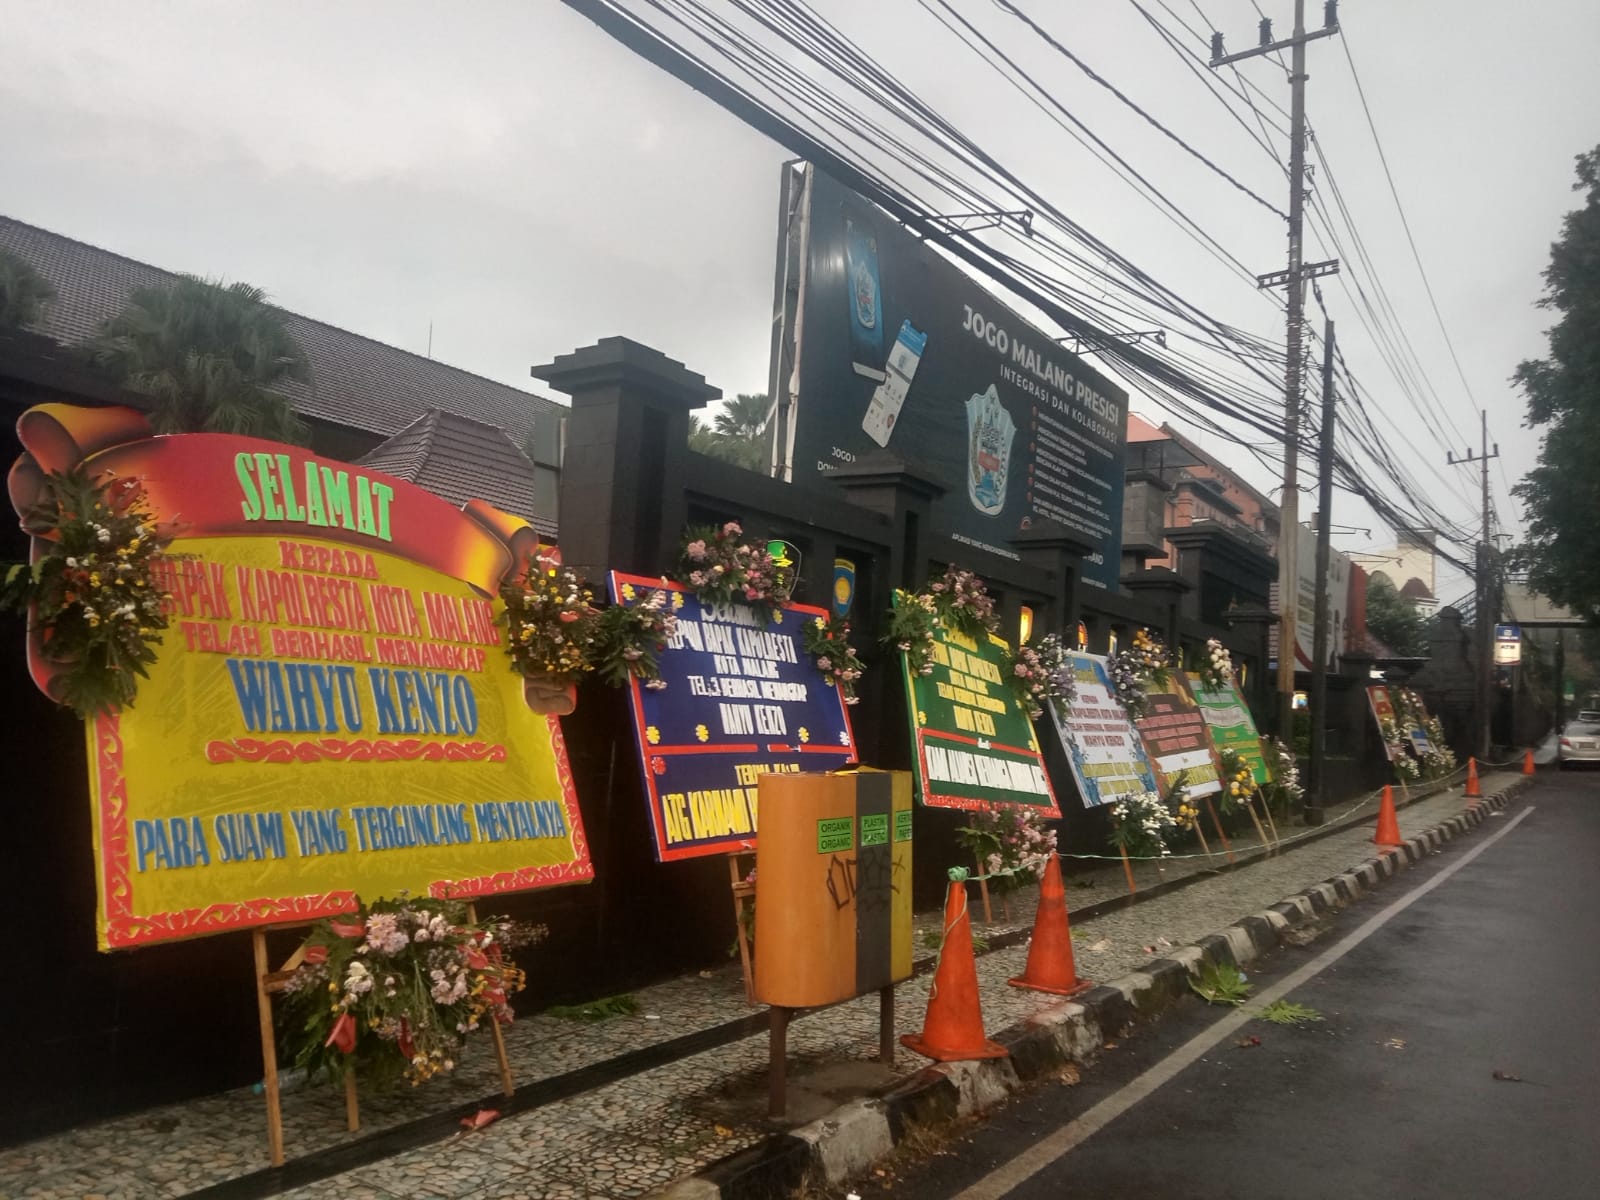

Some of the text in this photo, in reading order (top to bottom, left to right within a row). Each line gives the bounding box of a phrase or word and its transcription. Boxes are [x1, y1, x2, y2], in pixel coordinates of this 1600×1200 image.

[962, 304, 1119, 426] JOGO MALANG PRESISI
[1000, 363, 1049, 404] INTEGRASI
[1051, 394, 1070, 416] DAN
[1072, 408, 1117, 445] KOLABORASI
[832, 446, 852, 462] JOGO
[235, 453, 394, 541] SELAMAT
[279, 541, 378, 580] KEPADA
[237, 565, 370, 632] KAPOLRESTA
[368, 584, 423, 638] KOTA
[180, 621, 487, 673] TELAH BERHASIL MENANGKAP
[227, 658, 479, 737] WAHYU KENZO
[134, 800, 567, 873] PARA SUAMI YANG TERGUNCANG MENTALNYA
[821, 821, 851, 832] ORGANIK
[821, 837, 851, 849] ORGANIC
